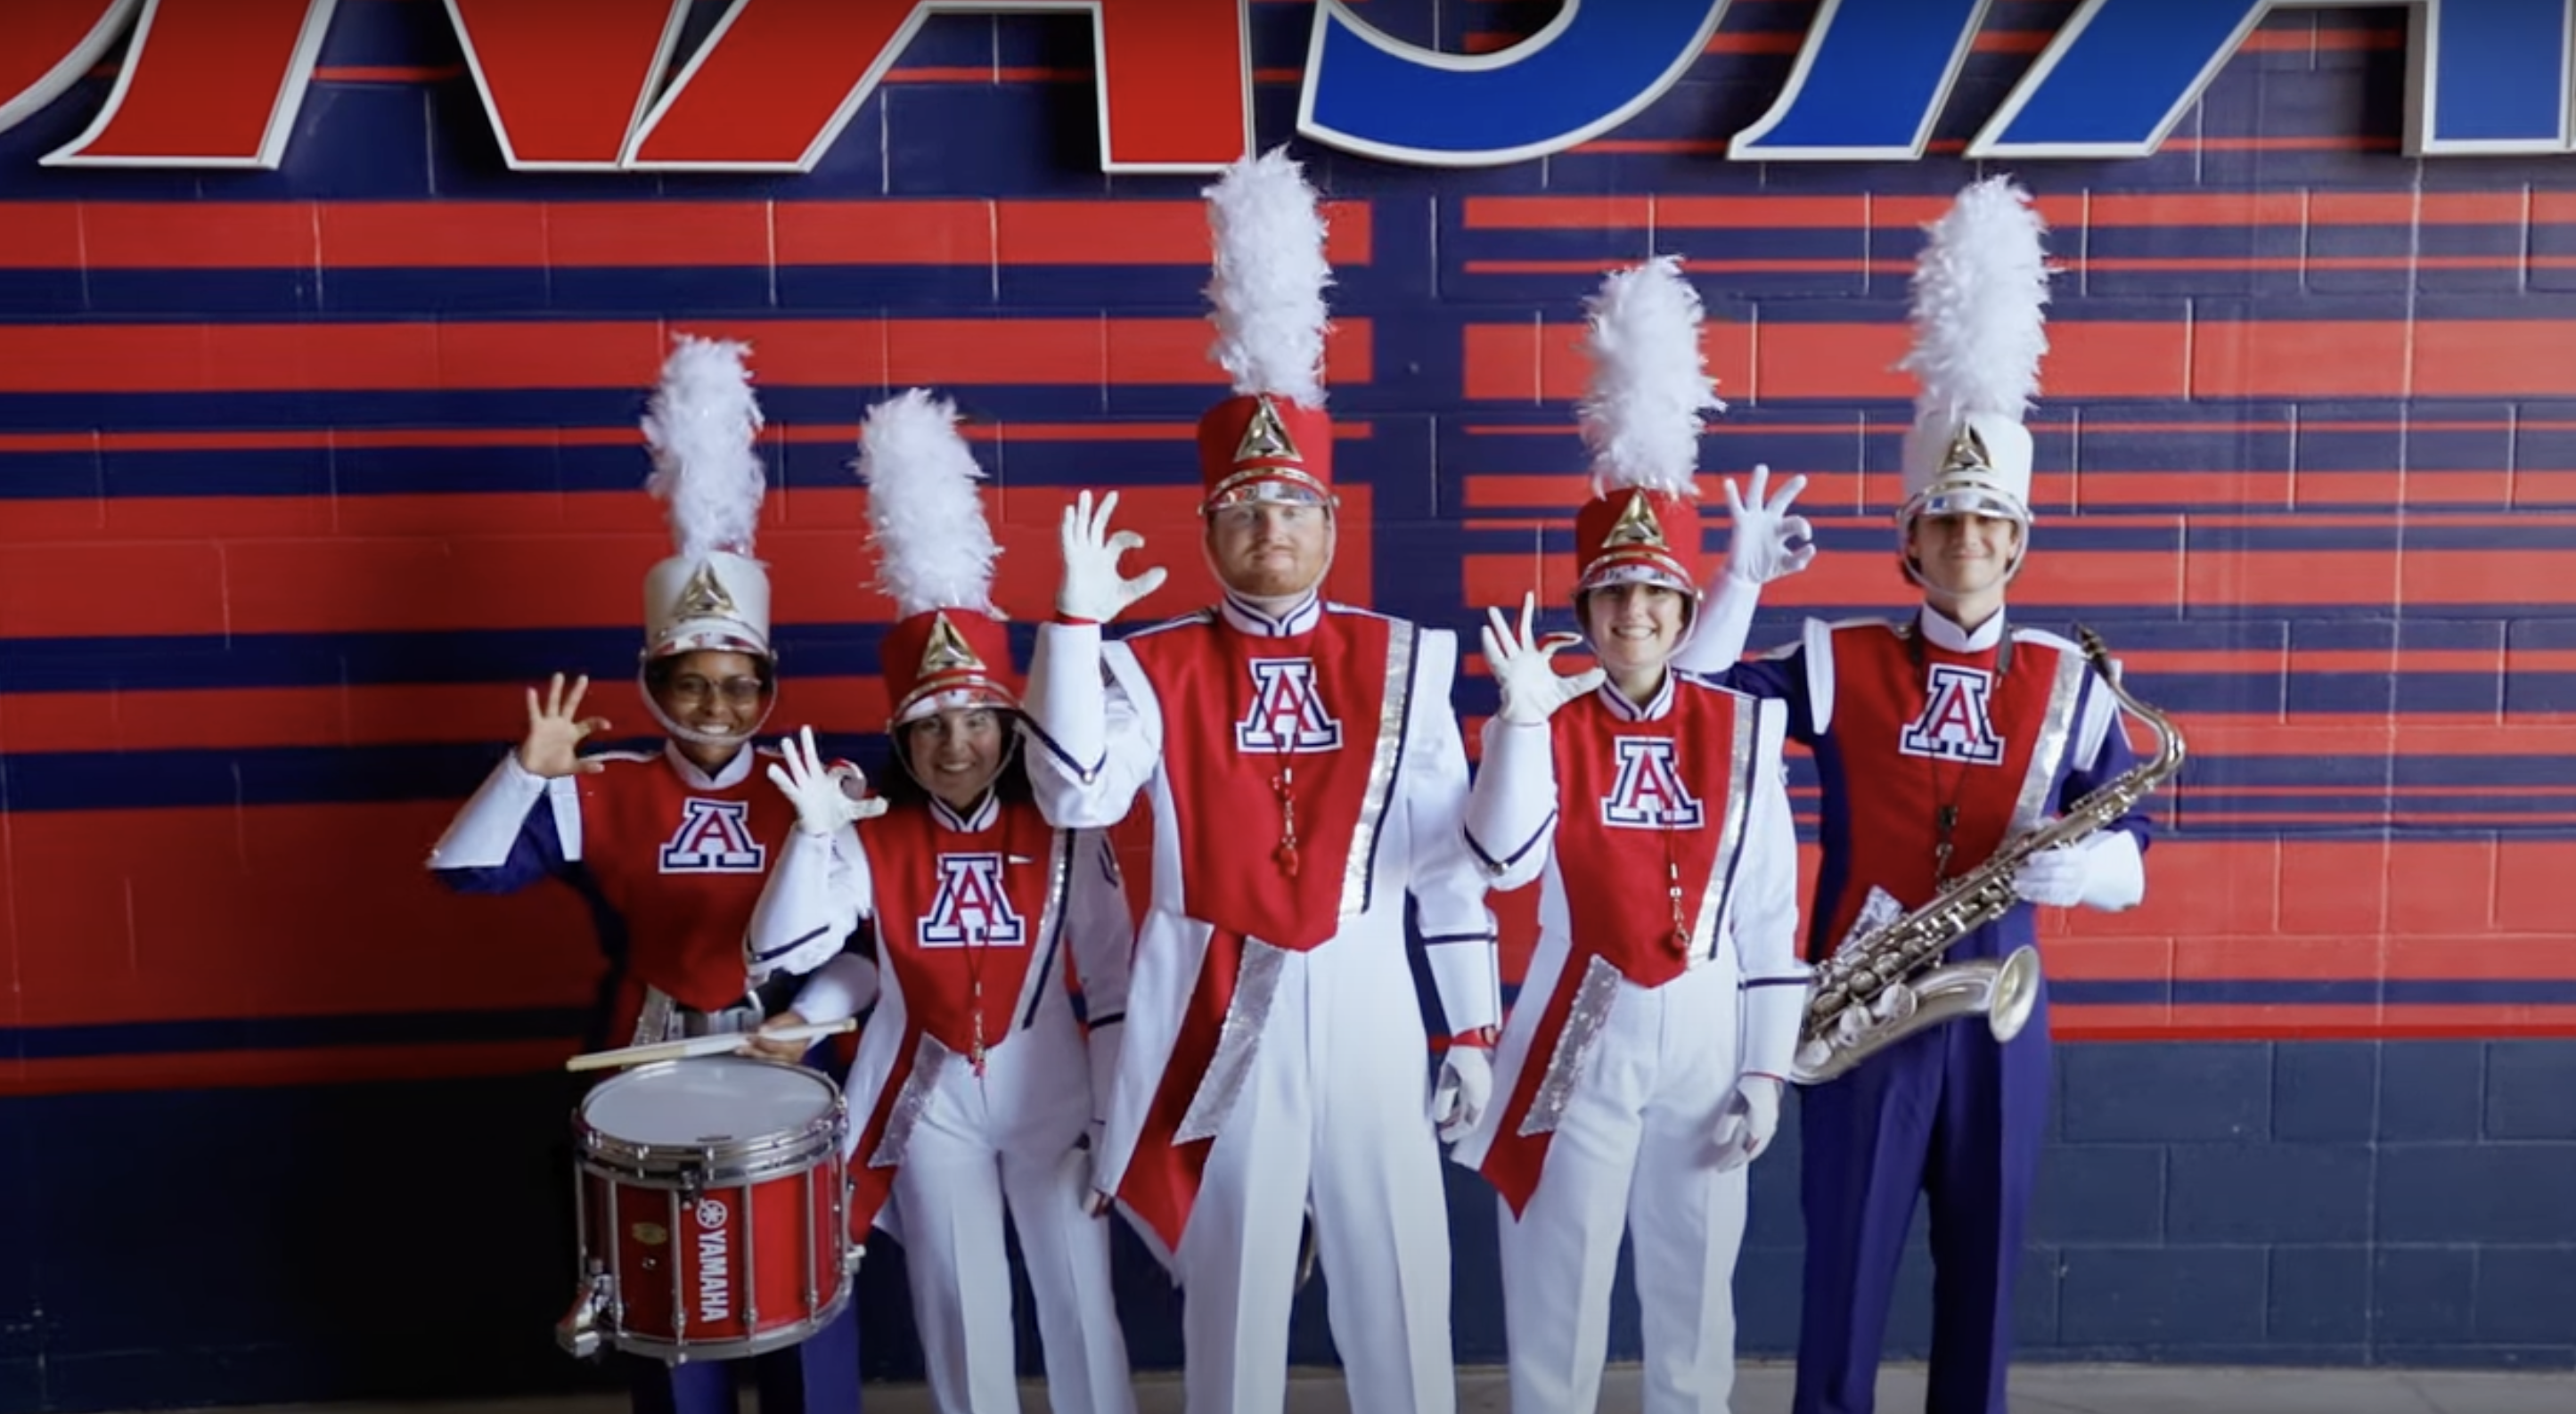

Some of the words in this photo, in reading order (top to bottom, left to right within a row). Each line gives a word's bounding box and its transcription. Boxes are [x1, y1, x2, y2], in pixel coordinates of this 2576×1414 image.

[1236, 657, 1344, 753] A
[1899, 662, 2006, 766] A
[1601, 735, 1705, 830] A
[658, 797, 766, 874] A
[918, 853, 1026, 947] A
[698, 1229, 729, 1322] YAMAHA
